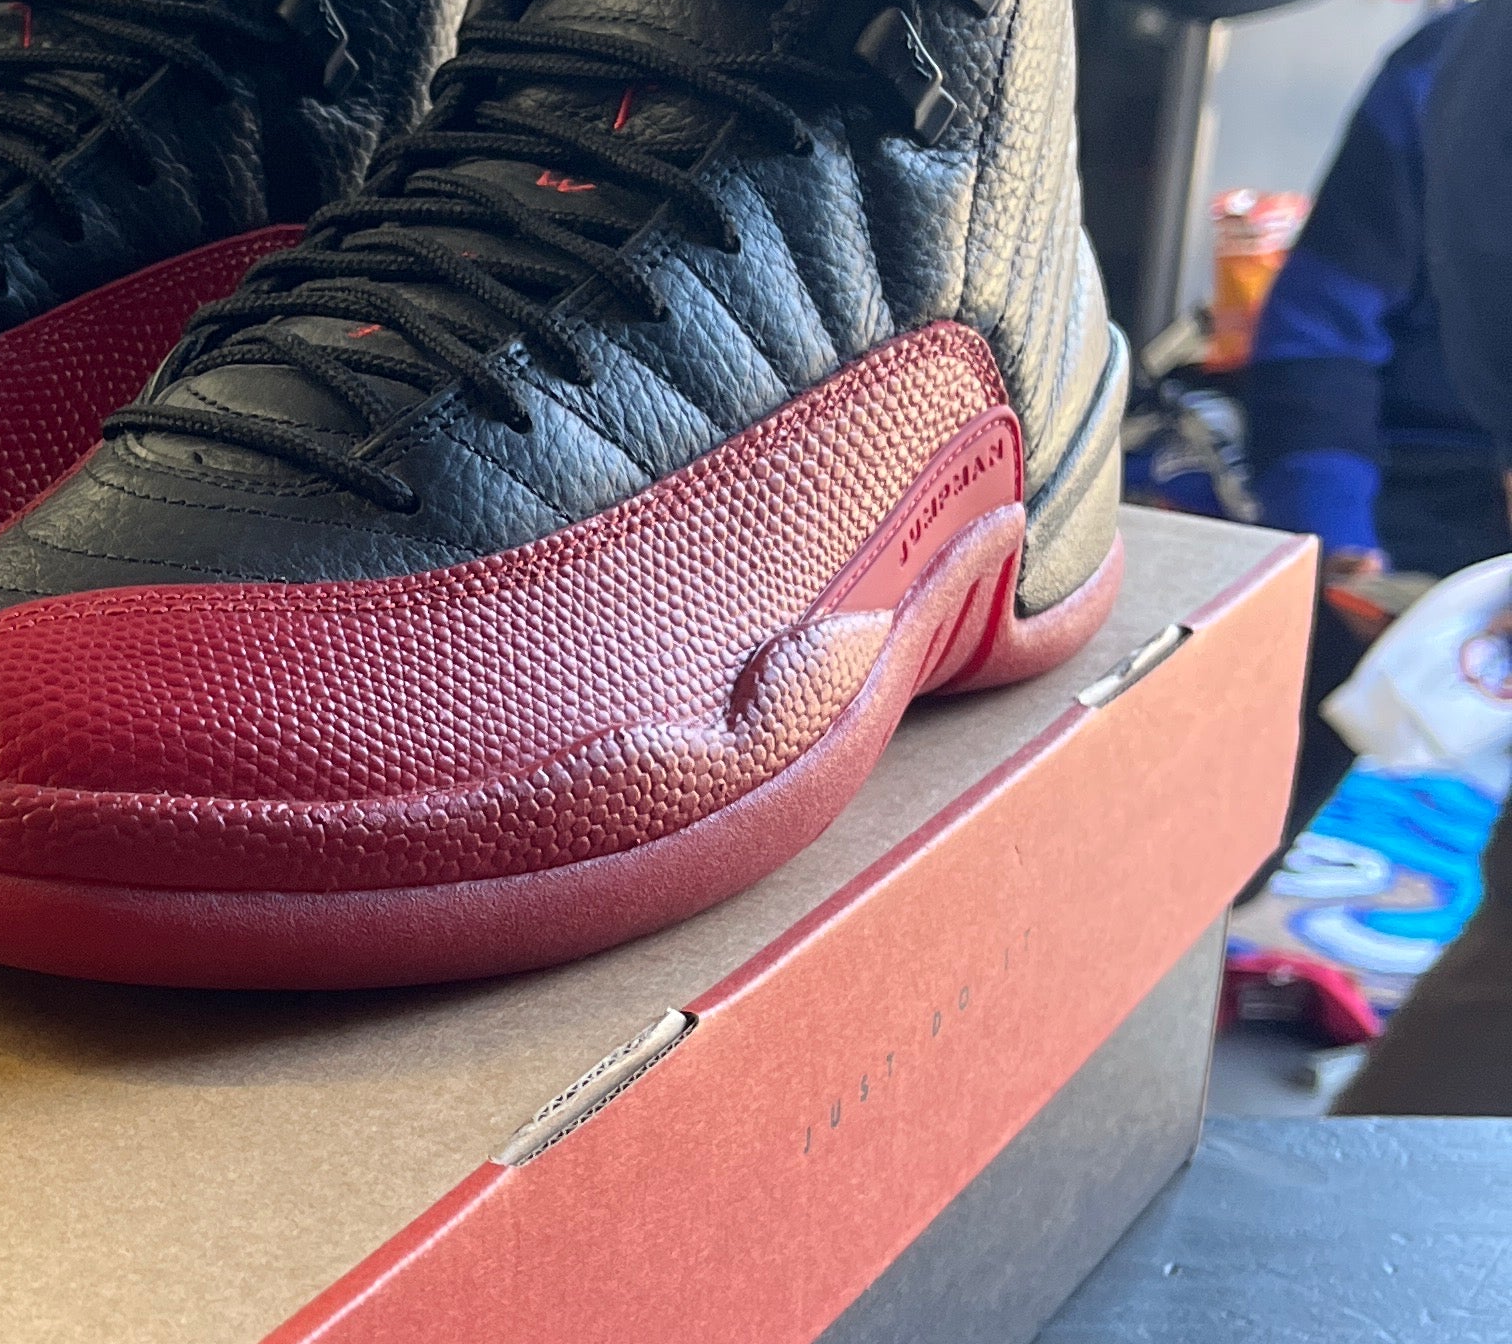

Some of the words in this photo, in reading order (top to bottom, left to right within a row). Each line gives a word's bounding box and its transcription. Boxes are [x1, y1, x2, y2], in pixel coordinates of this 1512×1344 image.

[899, 438, 1003, 567] JUMPMAN
[803, 1051, 895, 1154] JUST
[932, 986, 969, 1037] DO
